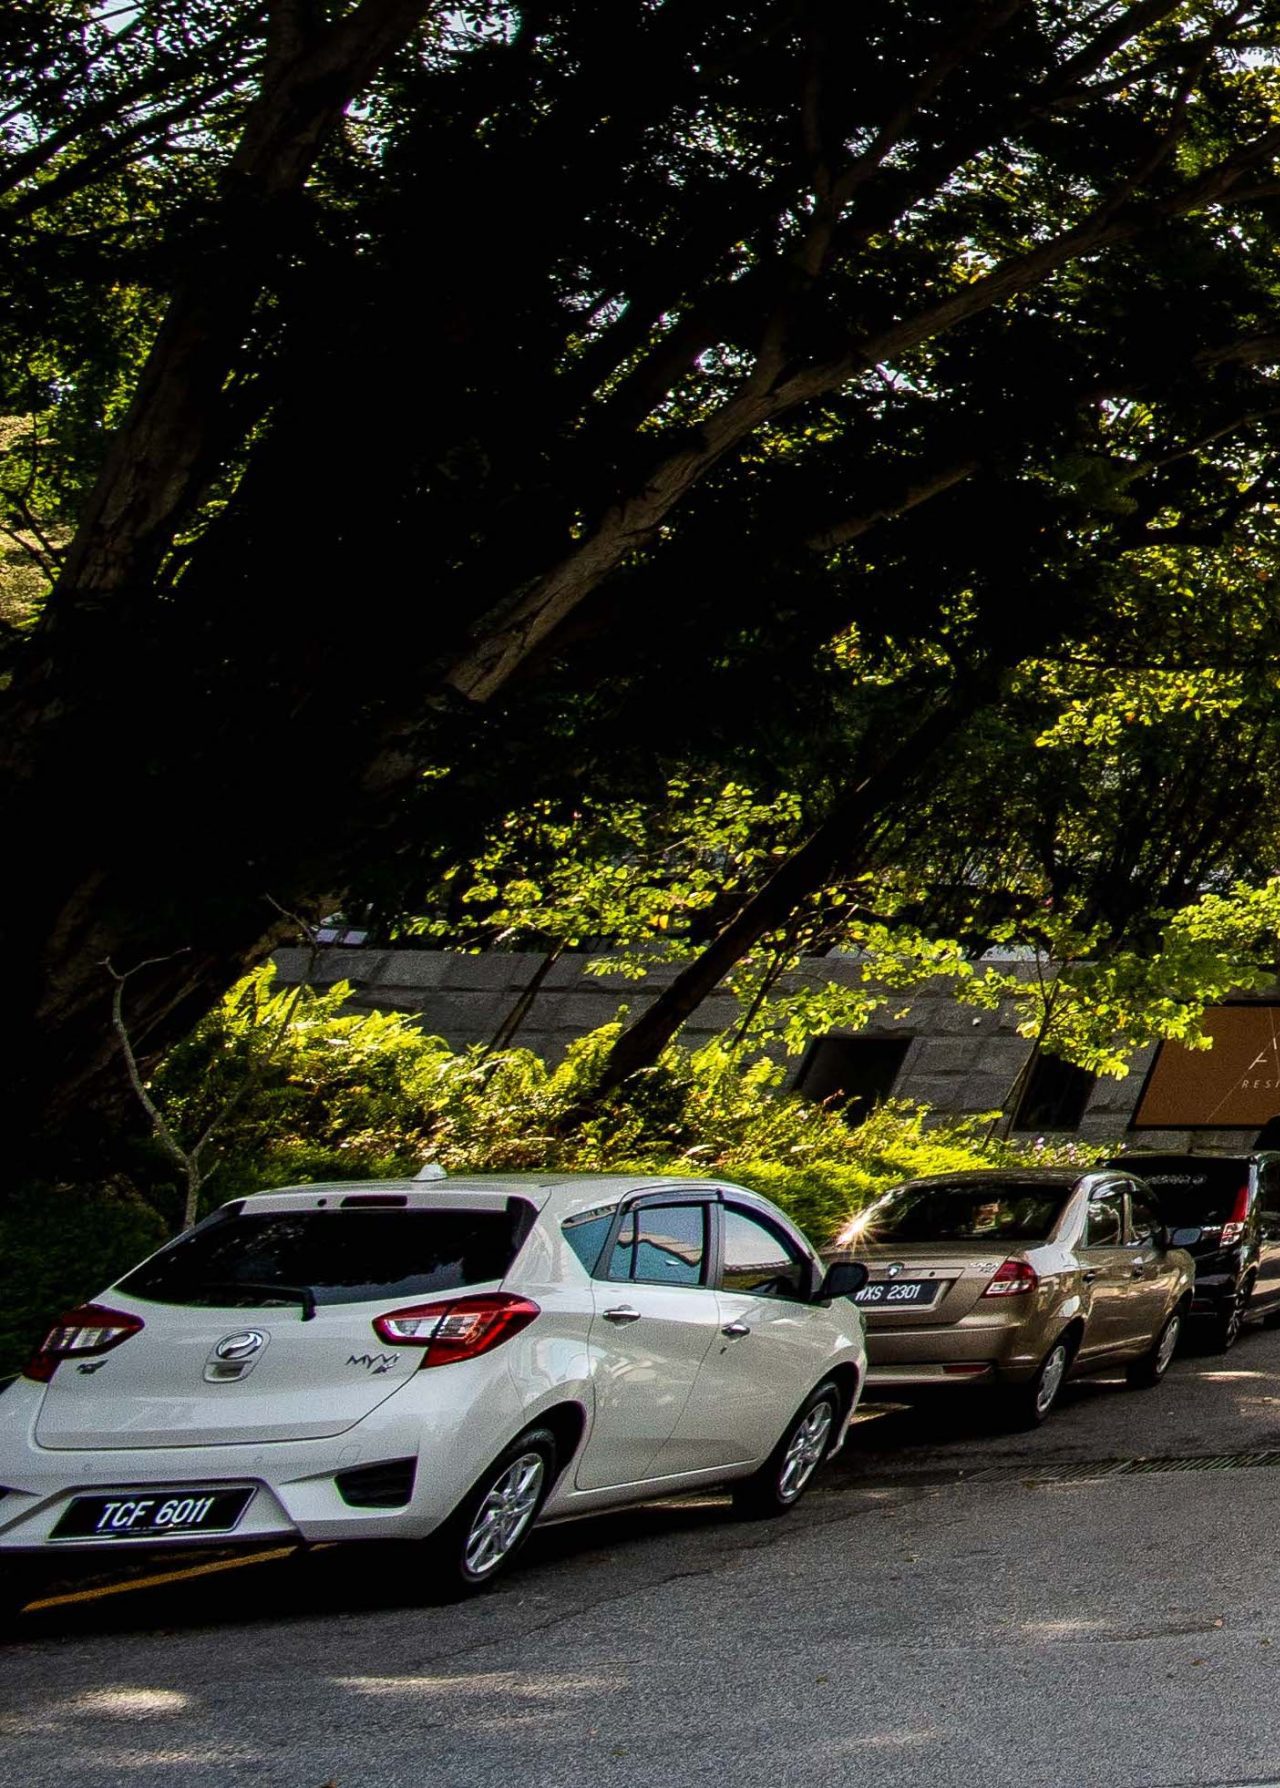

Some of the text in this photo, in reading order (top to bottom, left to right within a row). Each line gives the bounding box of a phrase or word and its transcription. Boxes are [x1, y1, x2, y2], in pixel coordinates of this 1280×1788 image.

[886, 1284, 921, 1299] 2301
[97, 1497, 215, 1528] TCF 6011
